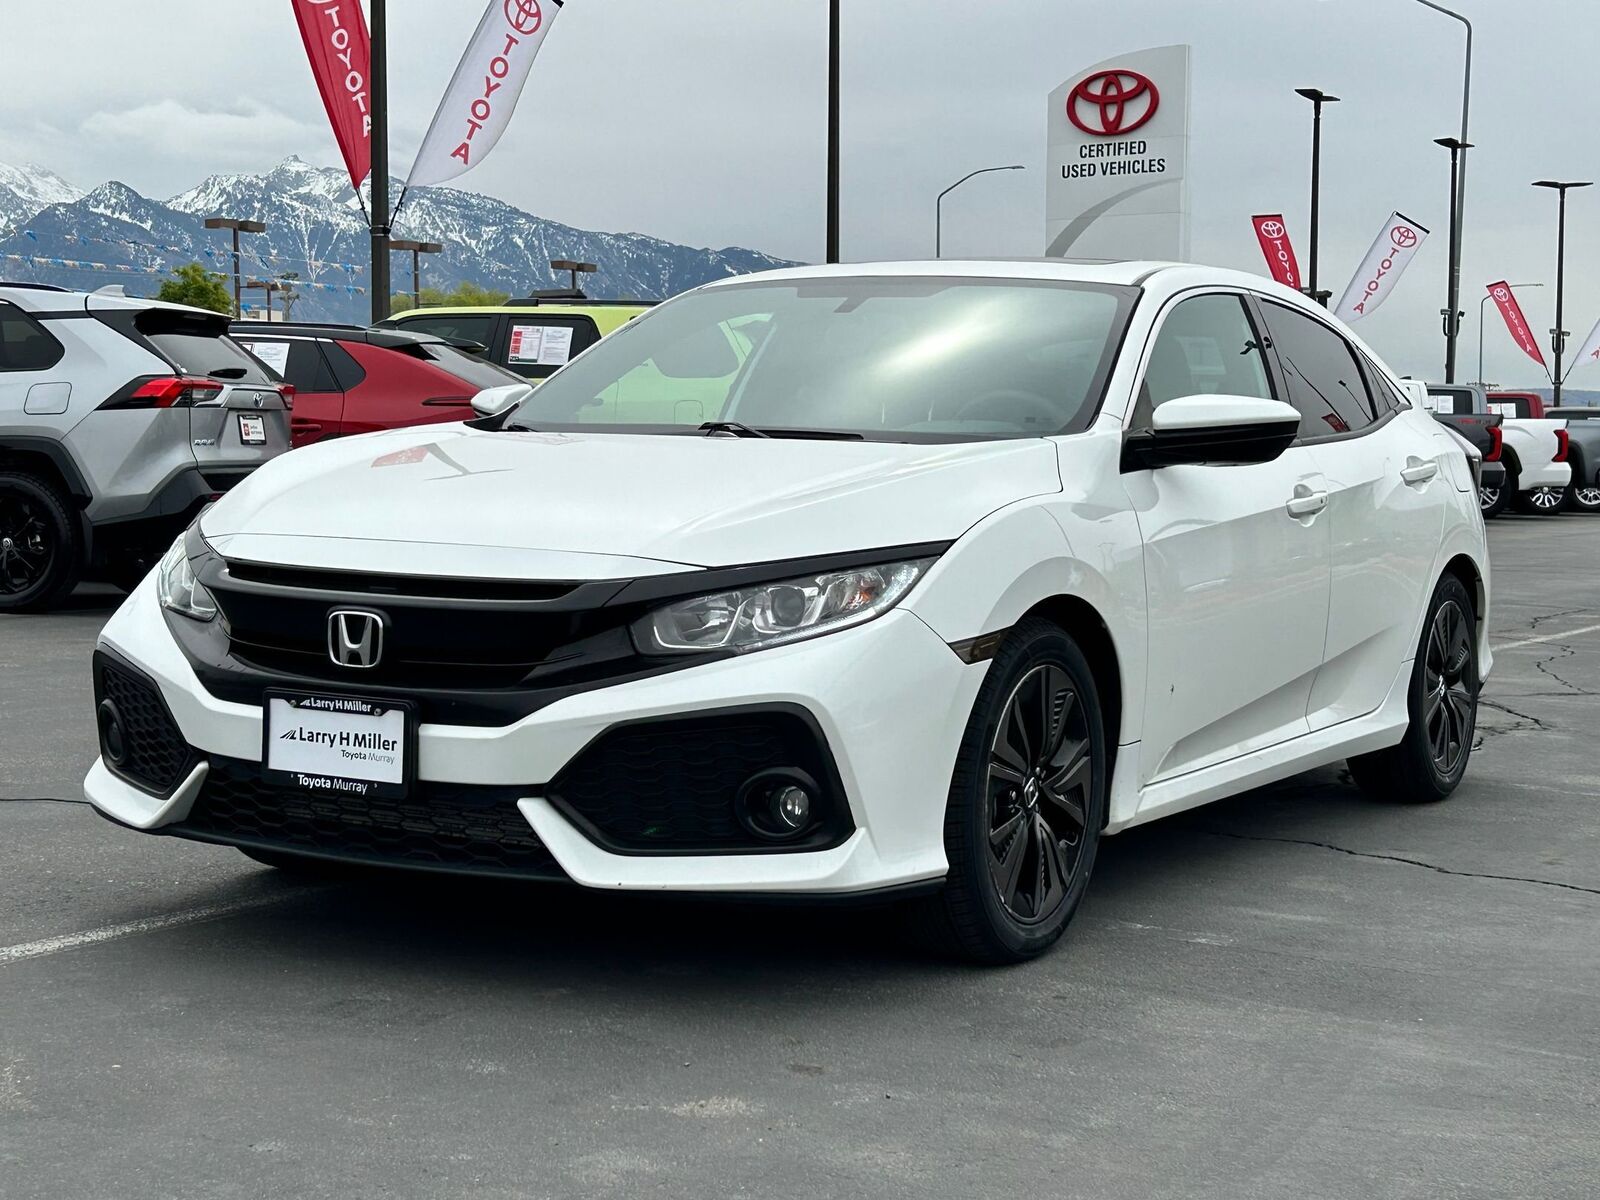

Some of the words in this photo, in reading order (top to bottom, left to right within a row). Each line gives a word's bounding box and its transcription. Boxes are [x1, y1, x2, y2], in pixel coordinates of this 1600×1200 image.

[450, 34, 519, 165] TOYOTA
[1079, 140, 1147, 158] CERTIFIED
[1061, 163, 1096, 178] USED
[1100, 158, 1166, 176] VEHICLES
[1273, 240, 1294, 286] TOYO
[1353, 247, 1399, 314] TOYOTA
[1505, 303, 1532, 352] TOYOTA
[311, 698, 334, 711] Larry
[335, 700, 344, 710] H
[344, 701, 371, 712] Miller
[299, 727, 336, 748] Larry
[340, 732, 350, 747] H
[353, 733, 398, 751] Miller
[341, 750, 367, 760] Toyota
[368, 752, 395, 764] Murray
[298, 774, 331, 789] Toyota
[332, 779, 368, 795] Murray
